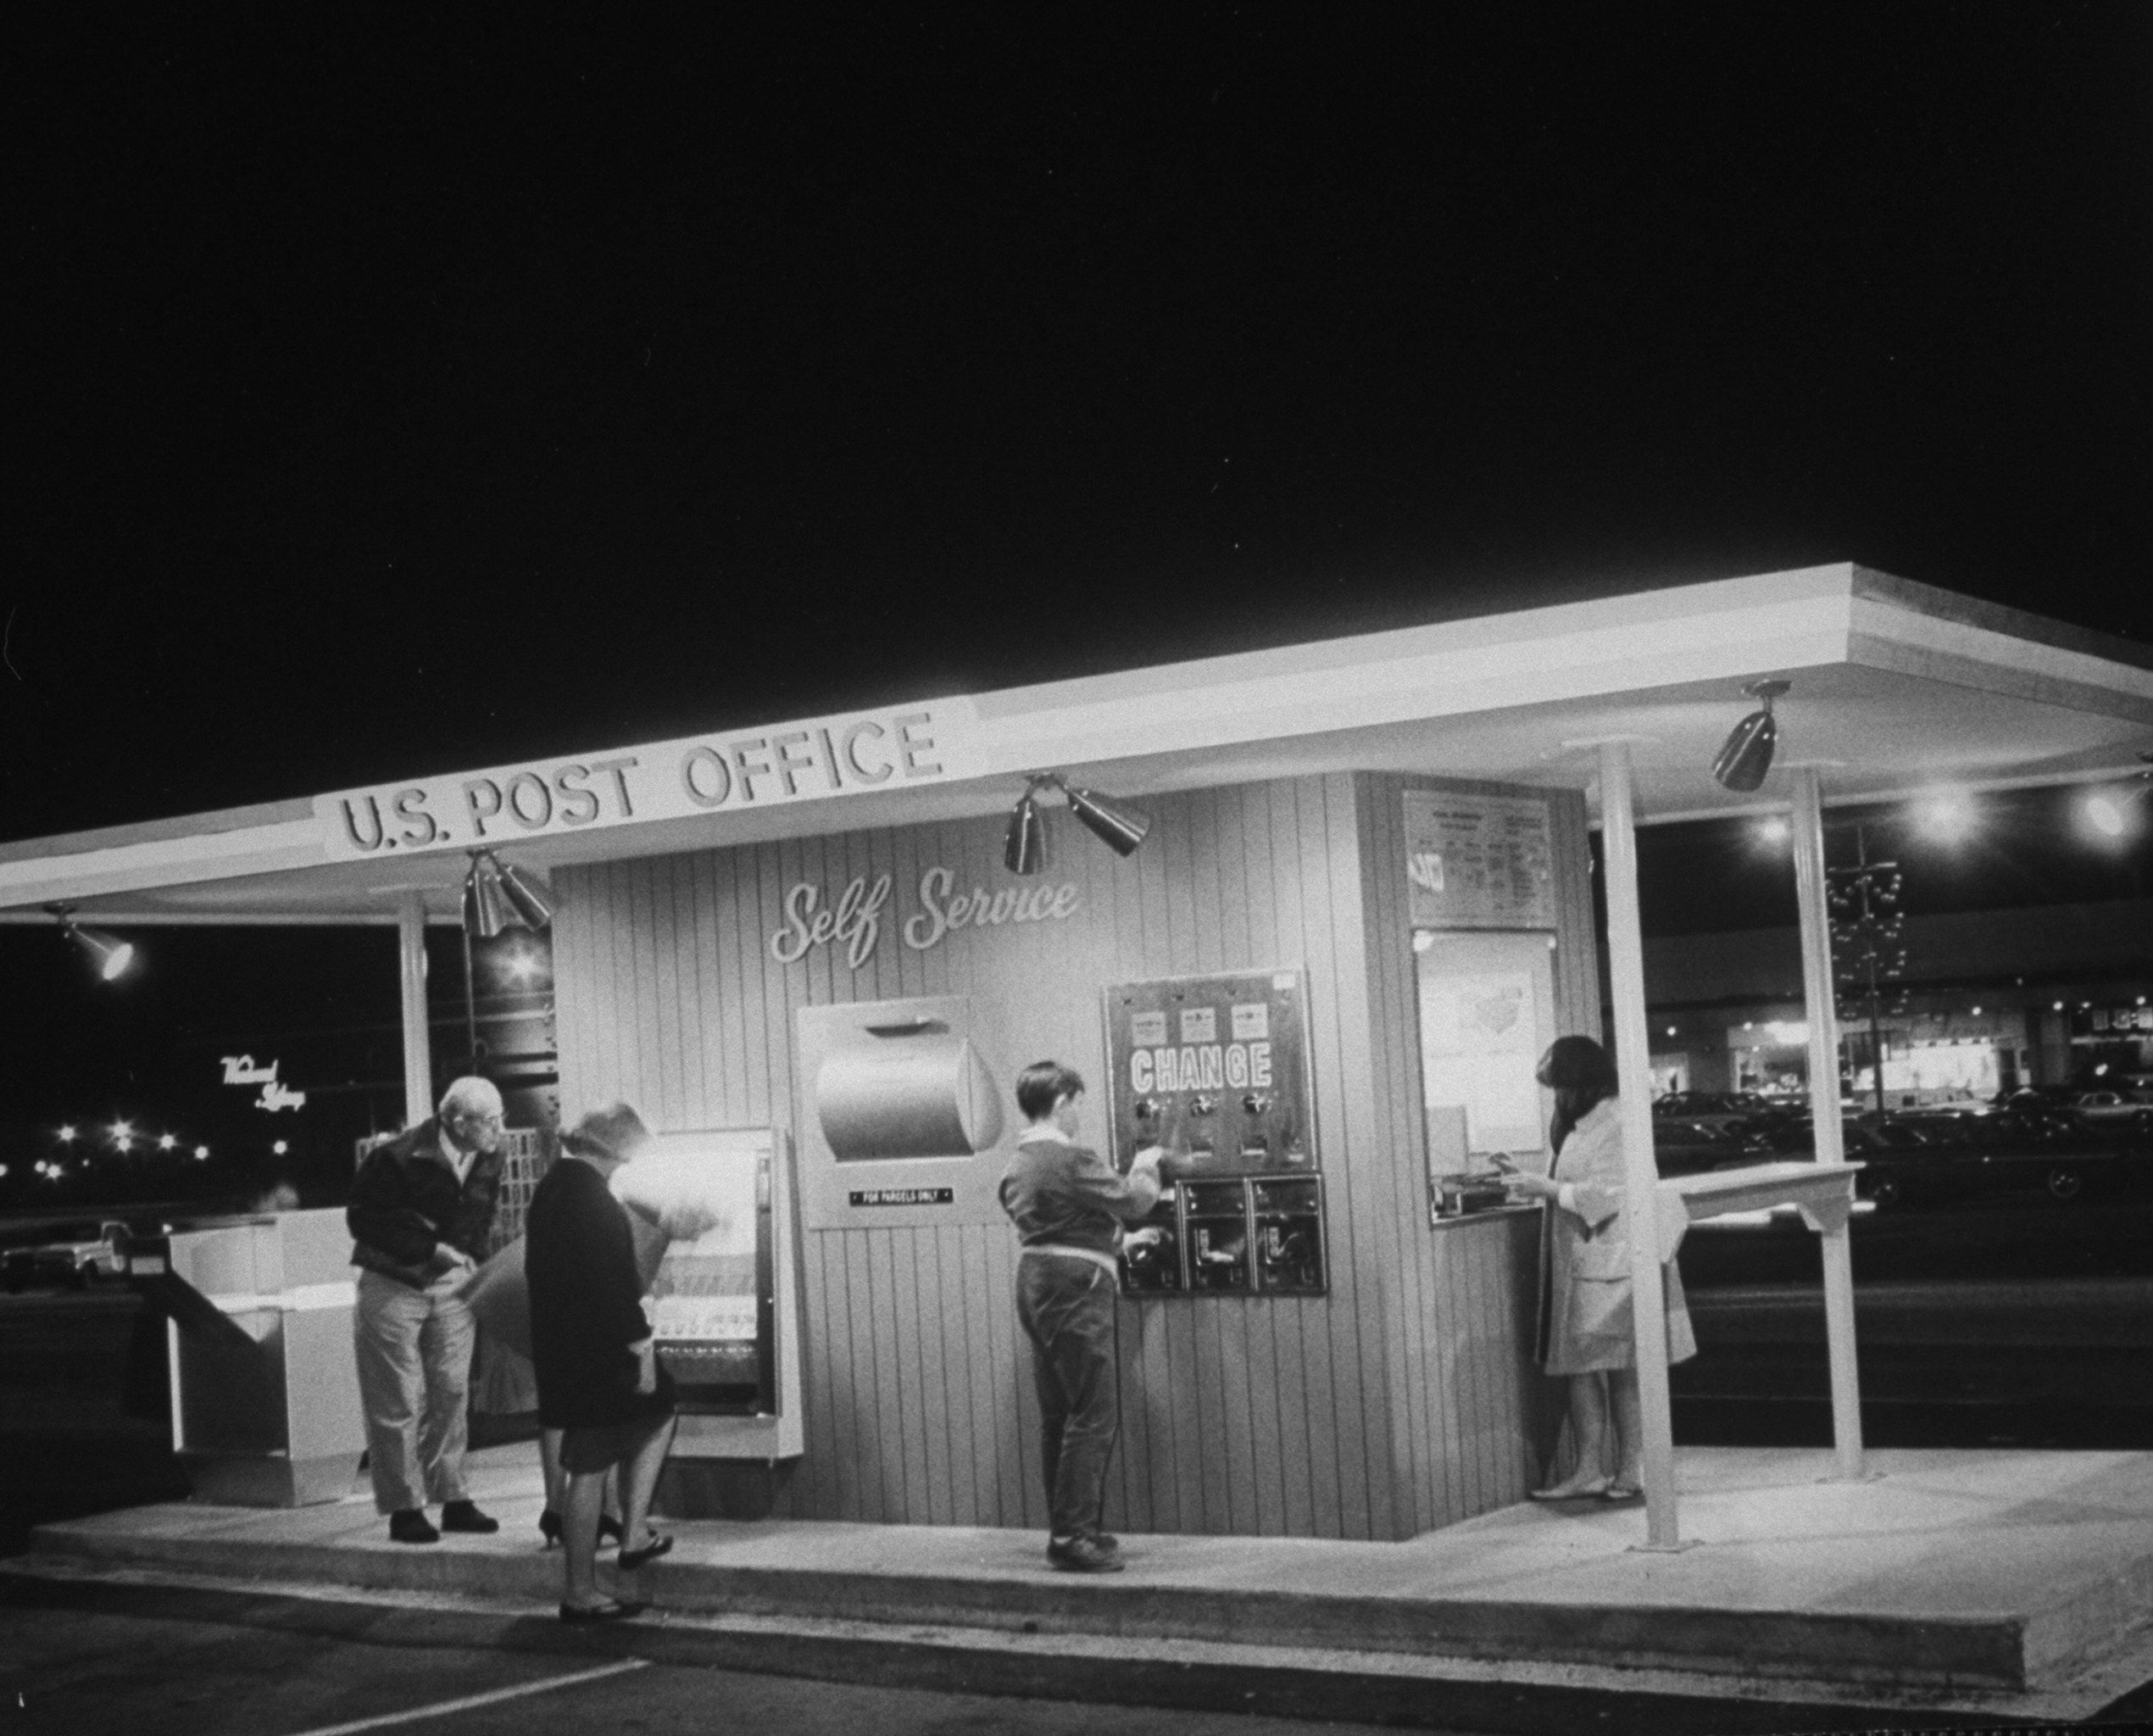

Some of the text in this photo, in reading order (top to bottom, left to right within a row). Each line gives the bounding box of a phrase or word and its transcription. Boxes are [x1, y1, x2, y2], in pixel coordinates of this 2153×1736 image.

[342, 712, 943, 851] U.S. POST OFFICE
[771, 867, 1088, 969] Self Service
[1130, 1042, 1272, 1094] CHANGE
